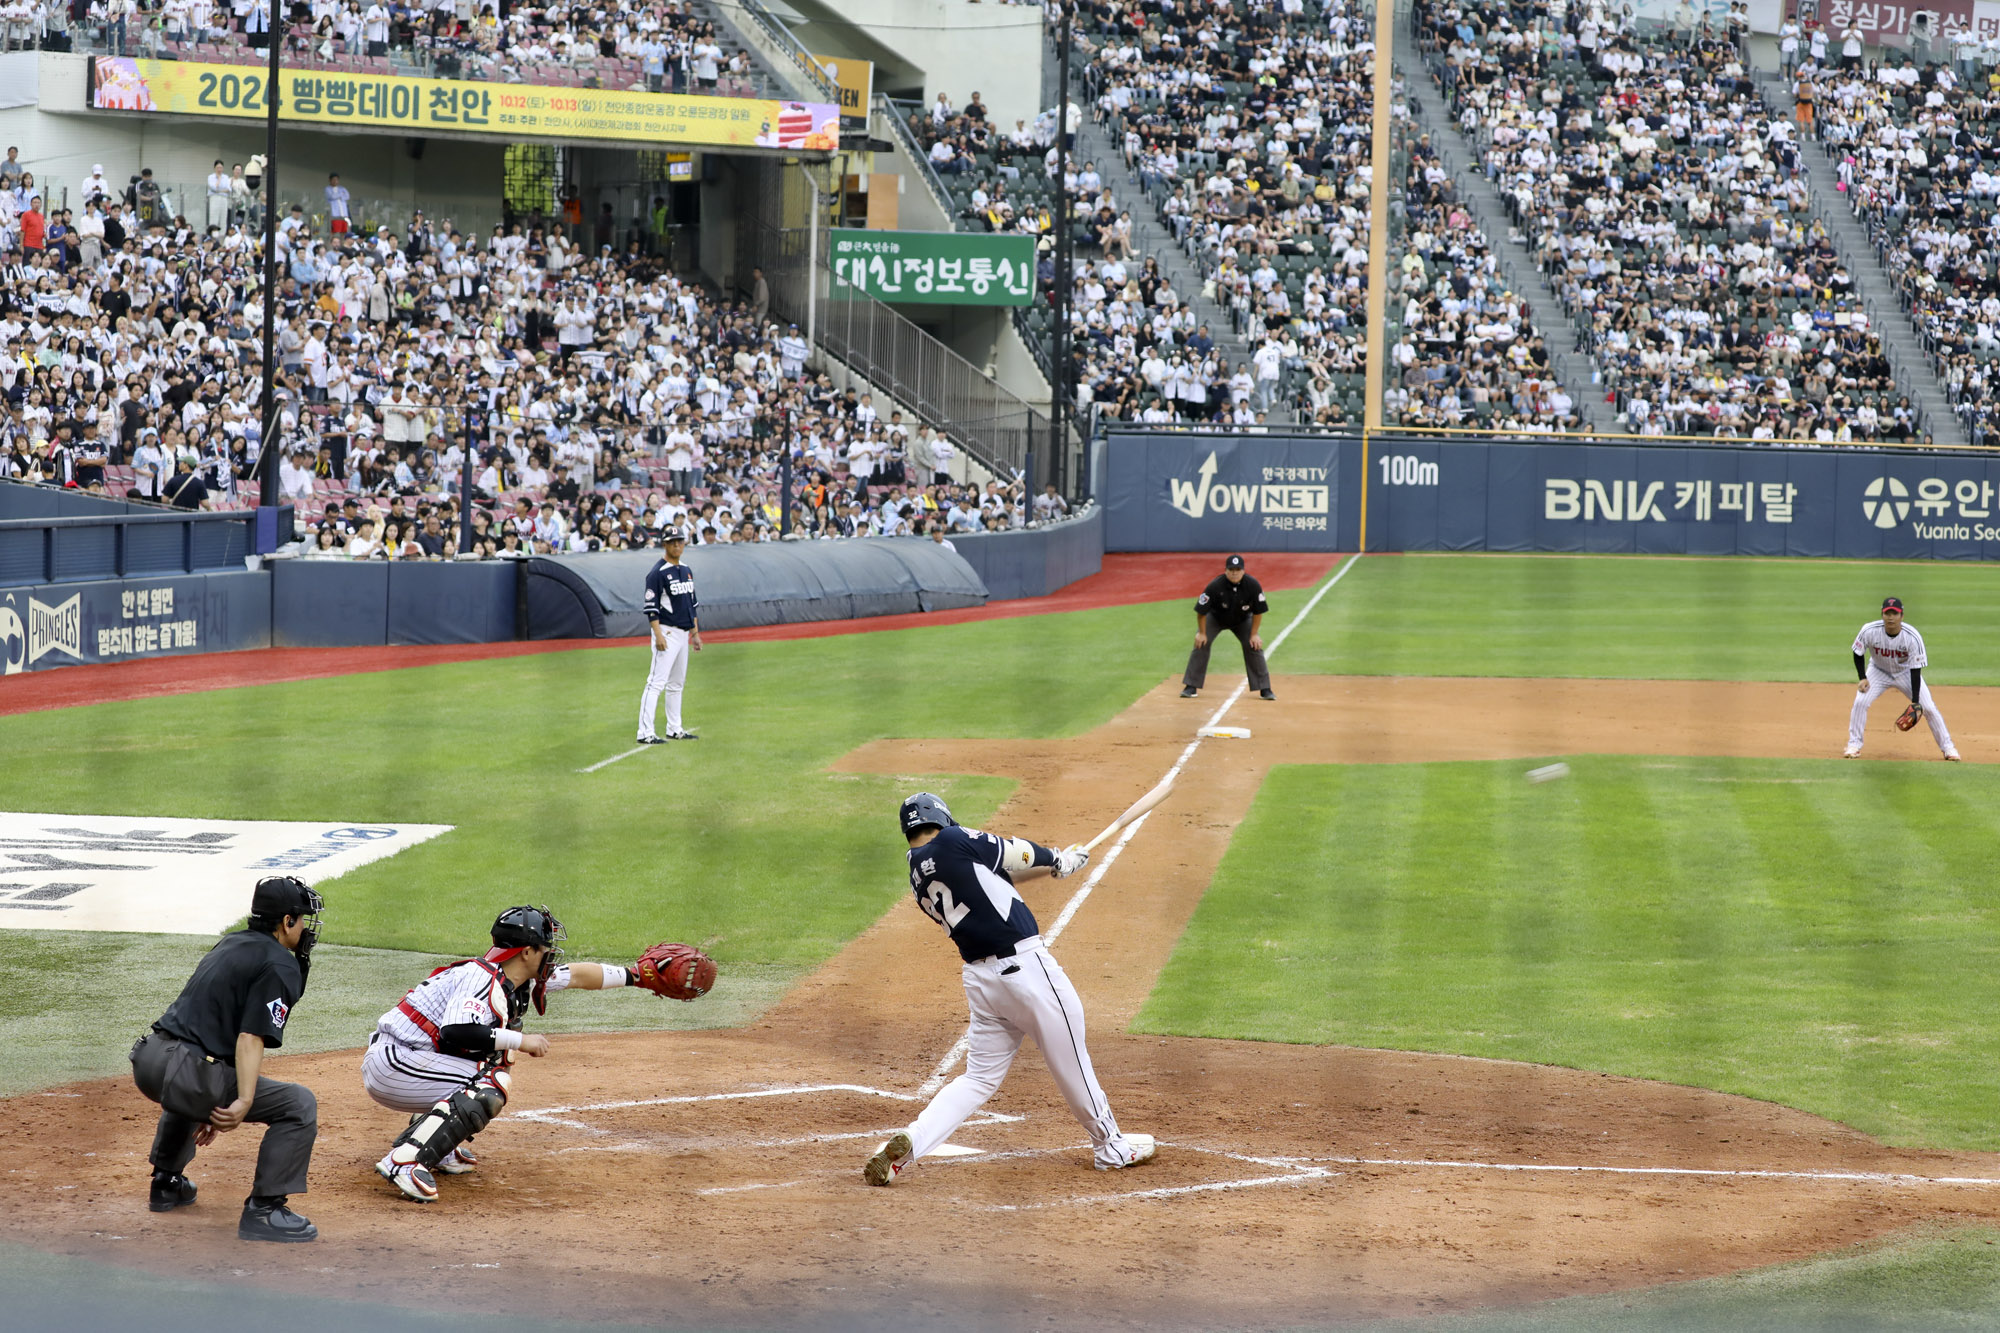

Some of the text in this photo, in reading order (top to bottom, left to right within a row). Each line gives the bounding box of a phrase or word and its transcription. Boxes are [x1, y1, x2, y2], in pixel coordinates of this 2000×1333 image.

[1829, 0, 1907, 34] 정심가
[292, 77, 420, 120] 빵빵데이
[428, 87, 492, 124] 천안
[835, 254, 1029, 296] 대신정보통신
[1262, 467, 1328, 481] 한국경제TV
[1379, 455, 1439, 486] 100m
[1545, 478, 1798, 523] BNK 캐피탈
[1915, 477, 2000, 519] 유안
[1262, 516, 1328, 531] 주식은 와우넷
[1913, 521, 1970, 541] Yuanta
[121, 587, 173, 619] 한 번 열면
[31, 602, 78, 655] PRINGLES
[97, 626, 133, 656] 멈추지
[134, 624, 158, 652] 않는
[159, 619, 197, 648] 즐거움!
[1873, 647, 1909, 659] TWINS
